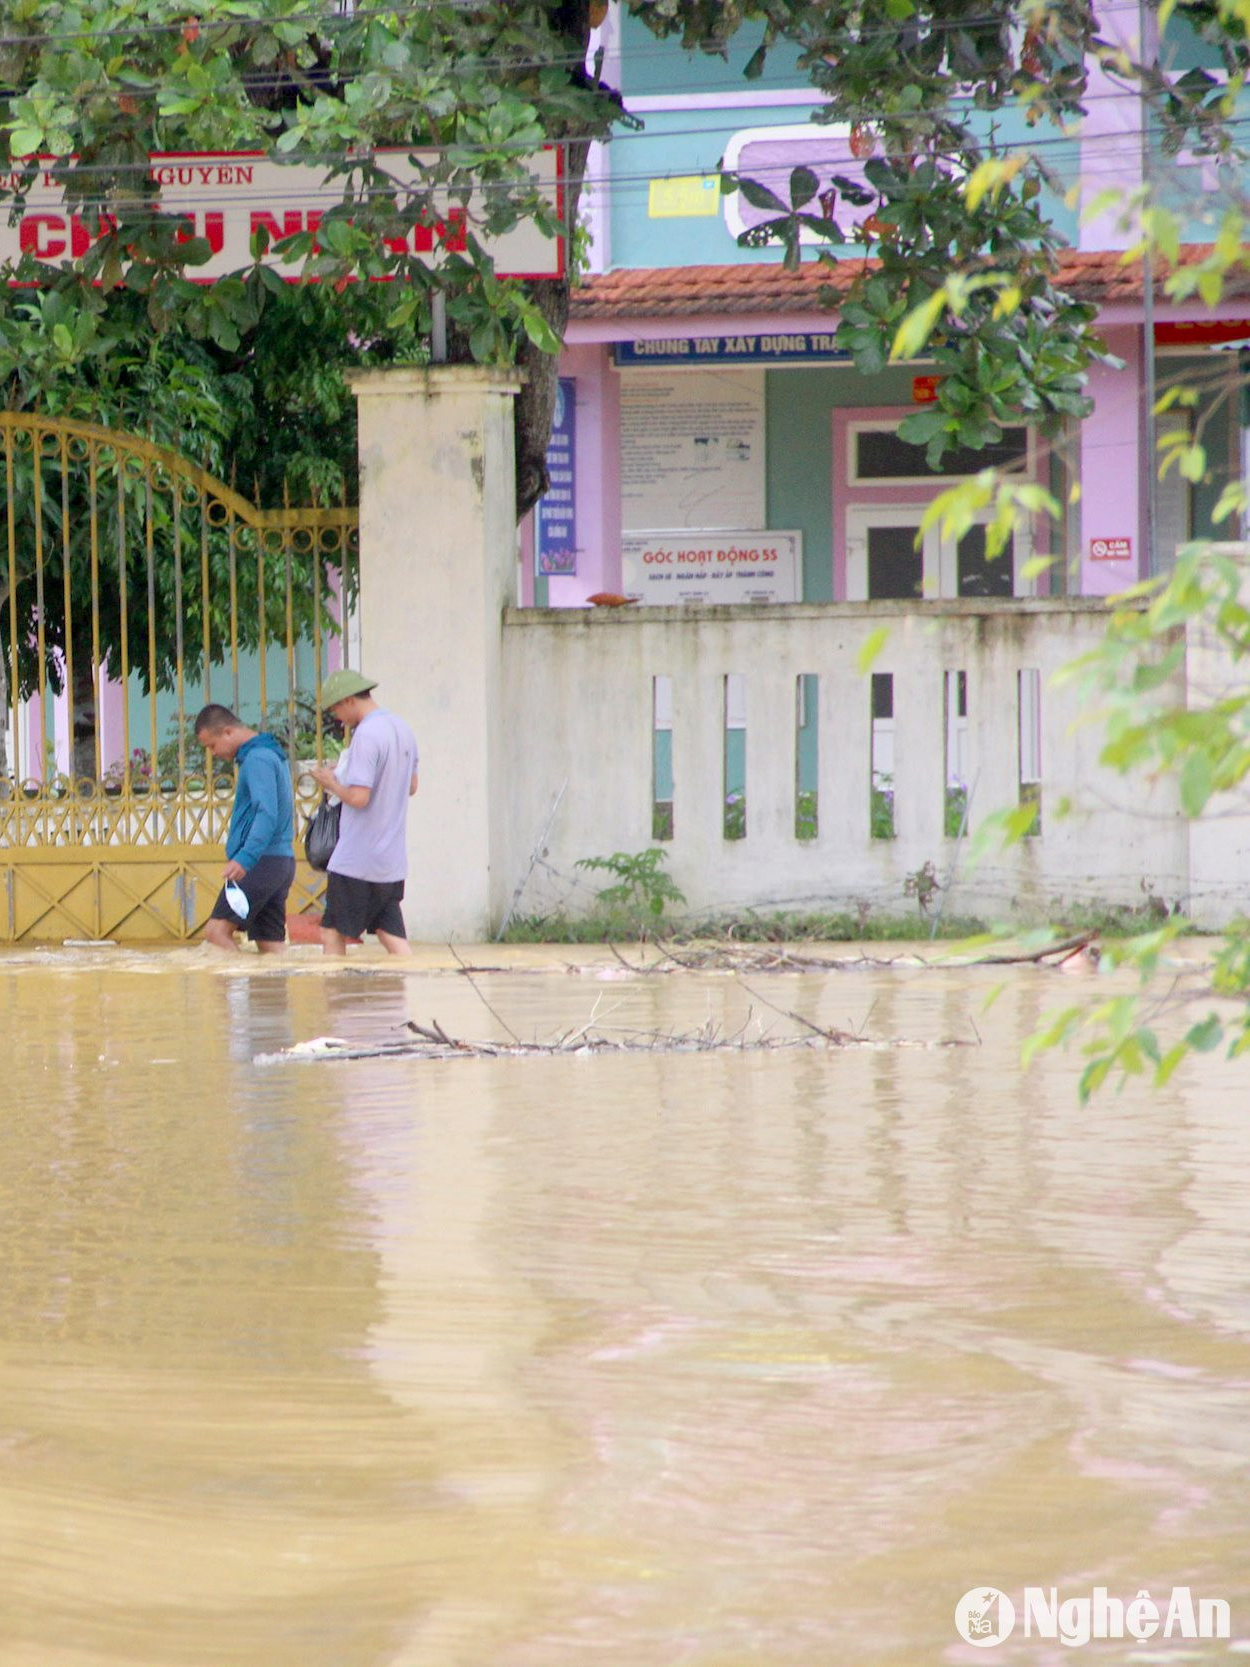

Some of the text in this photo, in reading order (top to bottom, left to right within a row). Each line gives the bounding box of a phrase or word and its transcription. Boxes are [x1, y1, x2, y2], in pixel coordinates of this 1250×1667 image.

[633, 338, 690, 355] CHUNG
[693, 336, 720, 353] TAY
[643, 545, 778, 566] GÓC HOẠT ĐỘNG 5S
